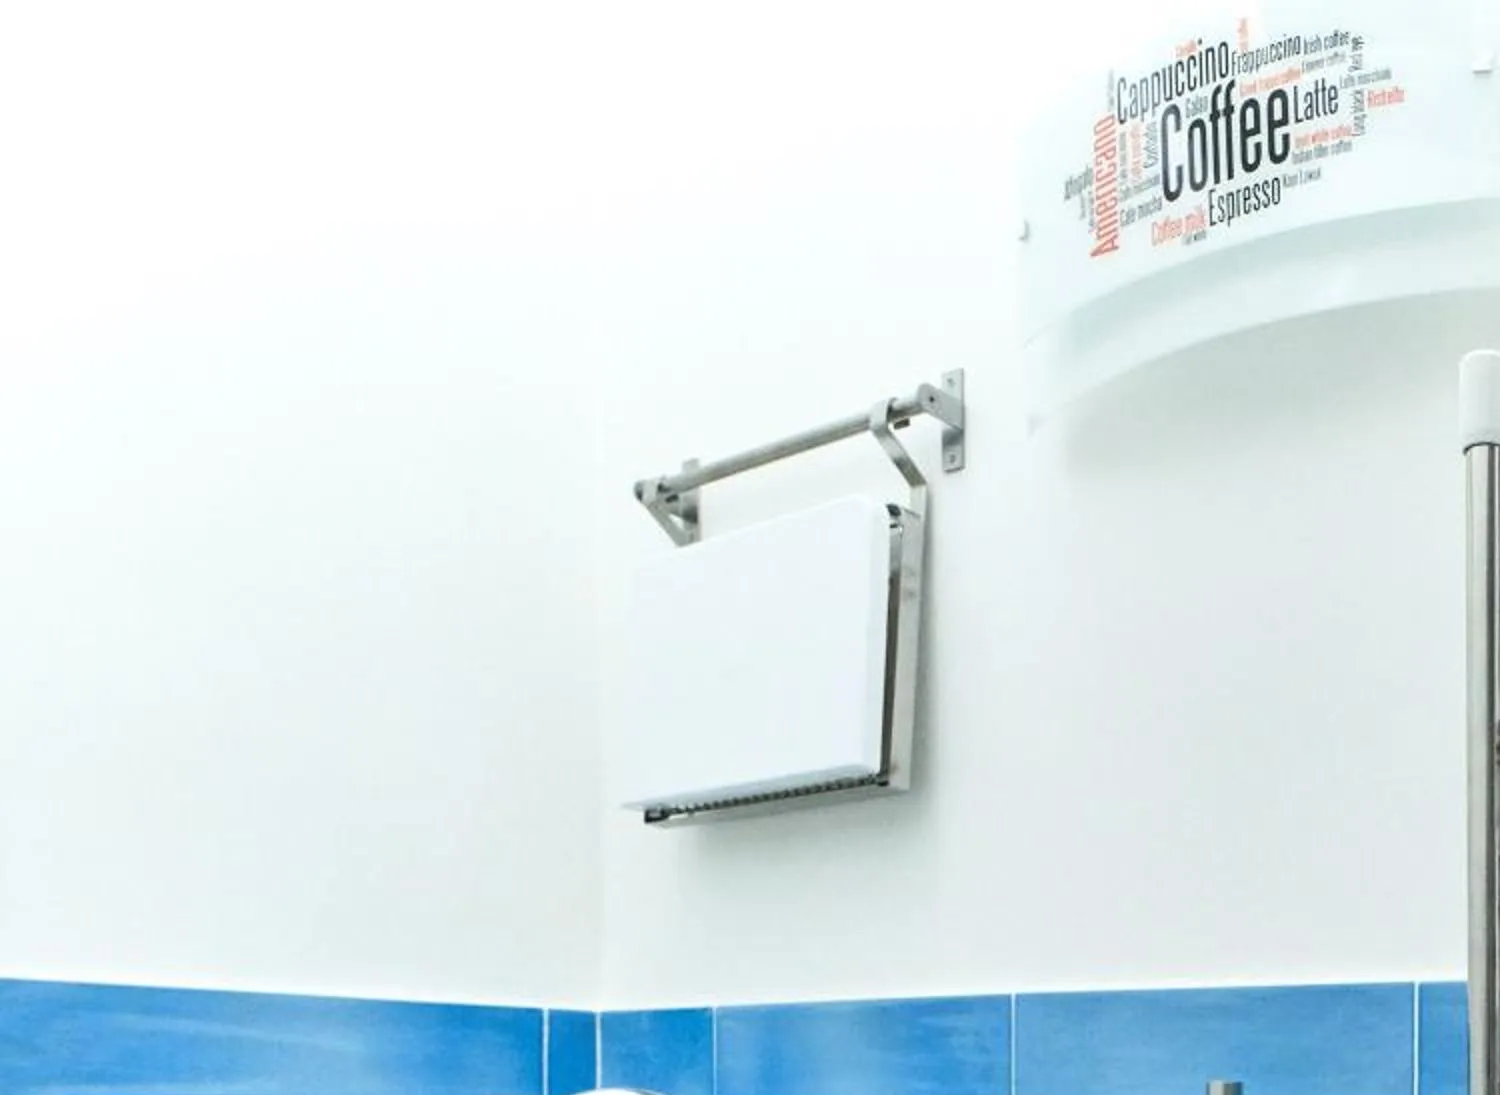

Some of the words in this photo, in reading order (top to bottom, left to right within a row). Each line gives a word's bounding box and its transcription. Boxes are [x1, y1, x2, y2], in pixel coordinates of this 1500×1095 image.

[1117, 37, 1229, 124] Cappuccino
[1231, 34, 1301, 76] Frappuccino
[1294, 77, 1339, 123] Latte
[1161, 78, 1291, 203] Coffee
[1090, 112, 1120, 258] Americano
[1208, 177, 1282, 227] Espresso
